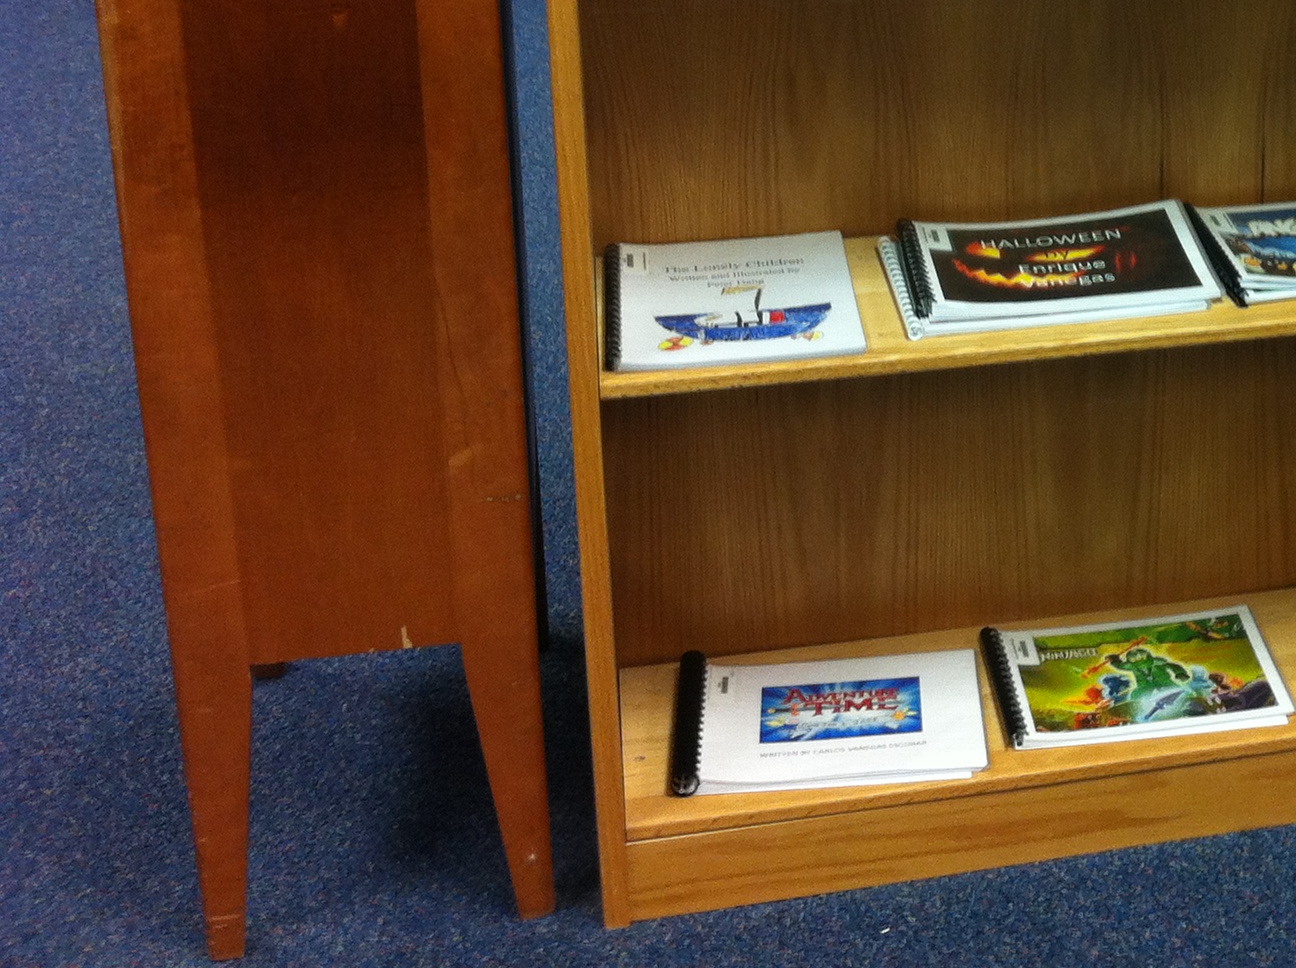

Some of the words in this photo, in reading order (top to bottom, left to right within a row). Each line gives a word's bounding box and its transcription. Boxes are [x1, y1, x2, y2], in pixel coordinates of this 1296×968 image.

[980, 228, 1122, 249] HALLOWEEN
[1018, 259, 1106, 274] Enrique
[784, 688, 900, 707] ADVENTURE
[805, 698, 898, 717] TIME
